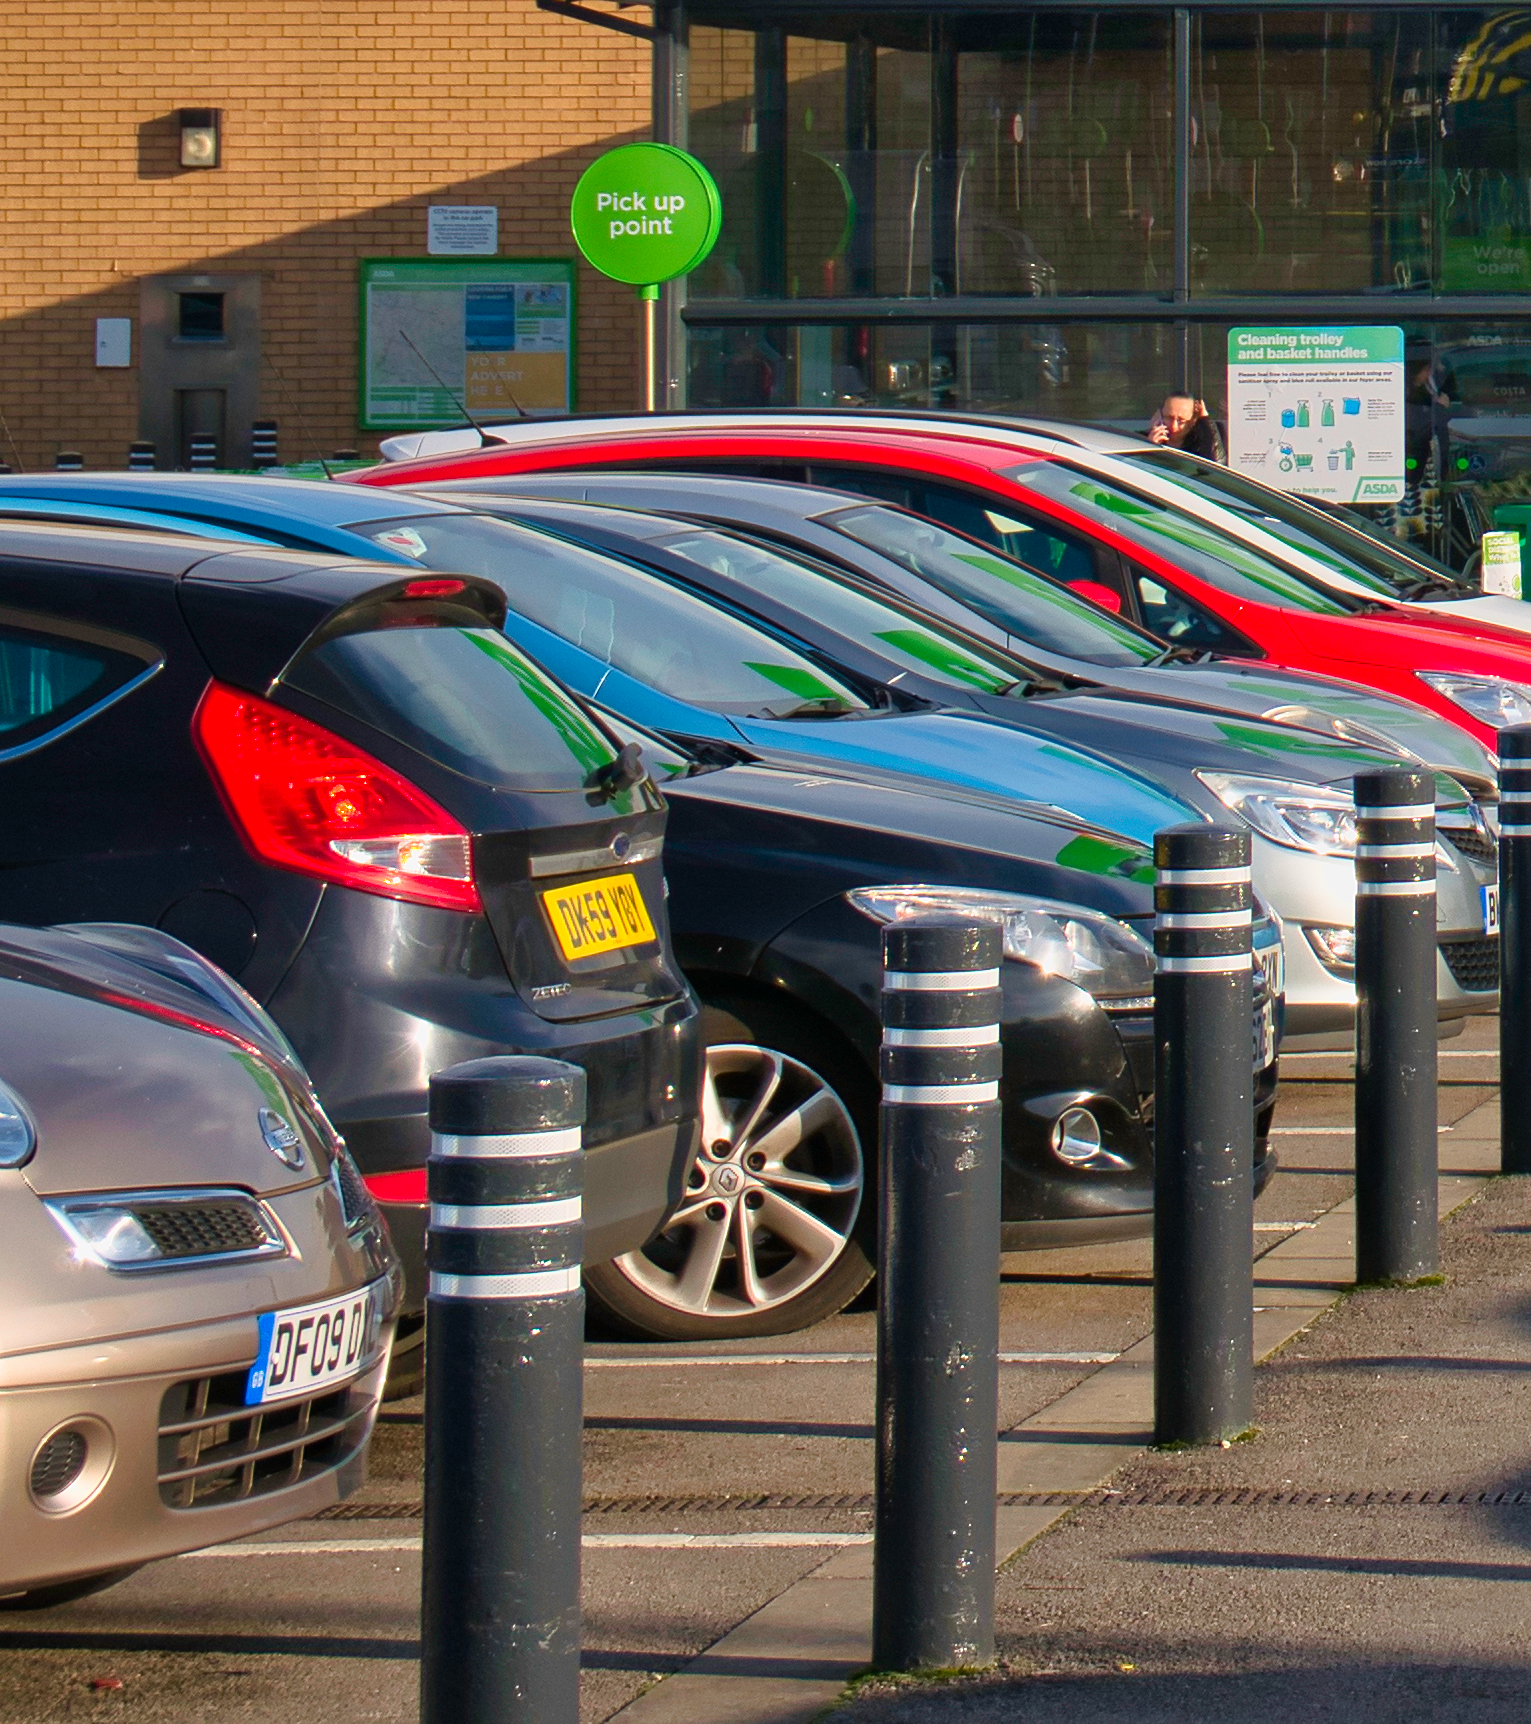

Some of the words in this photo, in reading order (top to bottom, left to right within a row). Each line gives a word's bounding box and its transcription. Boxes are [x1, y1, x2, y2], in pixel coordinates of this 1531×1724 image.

[597, 192, 647, 211] Pick
[654, 195, 685, 214] up
[610, 216, 673, 239] point
[1473, 246, 1525, 260] We're
[1477, 262, 1520, 275] open
[1238, 333, 1297, 346] Cleaning
[1300, 334, 1343, 346] trolley
[1238, 348, 1264, 359] and
[1267, 347, 1312, 359] basket
[1315, 347, 1368, 359] handles
[1493, 387, 1526, 396] COSTA
[1302, 487, 1320, 495] help
[1363, 484, 1398, 494] ASDA
[556, 890, 618, 949] DK59
[531, 983, 573, 1000] ZETEC
[269, 1308, 345, 1387] DF09
[251, 1370, 264, 1389] GB
